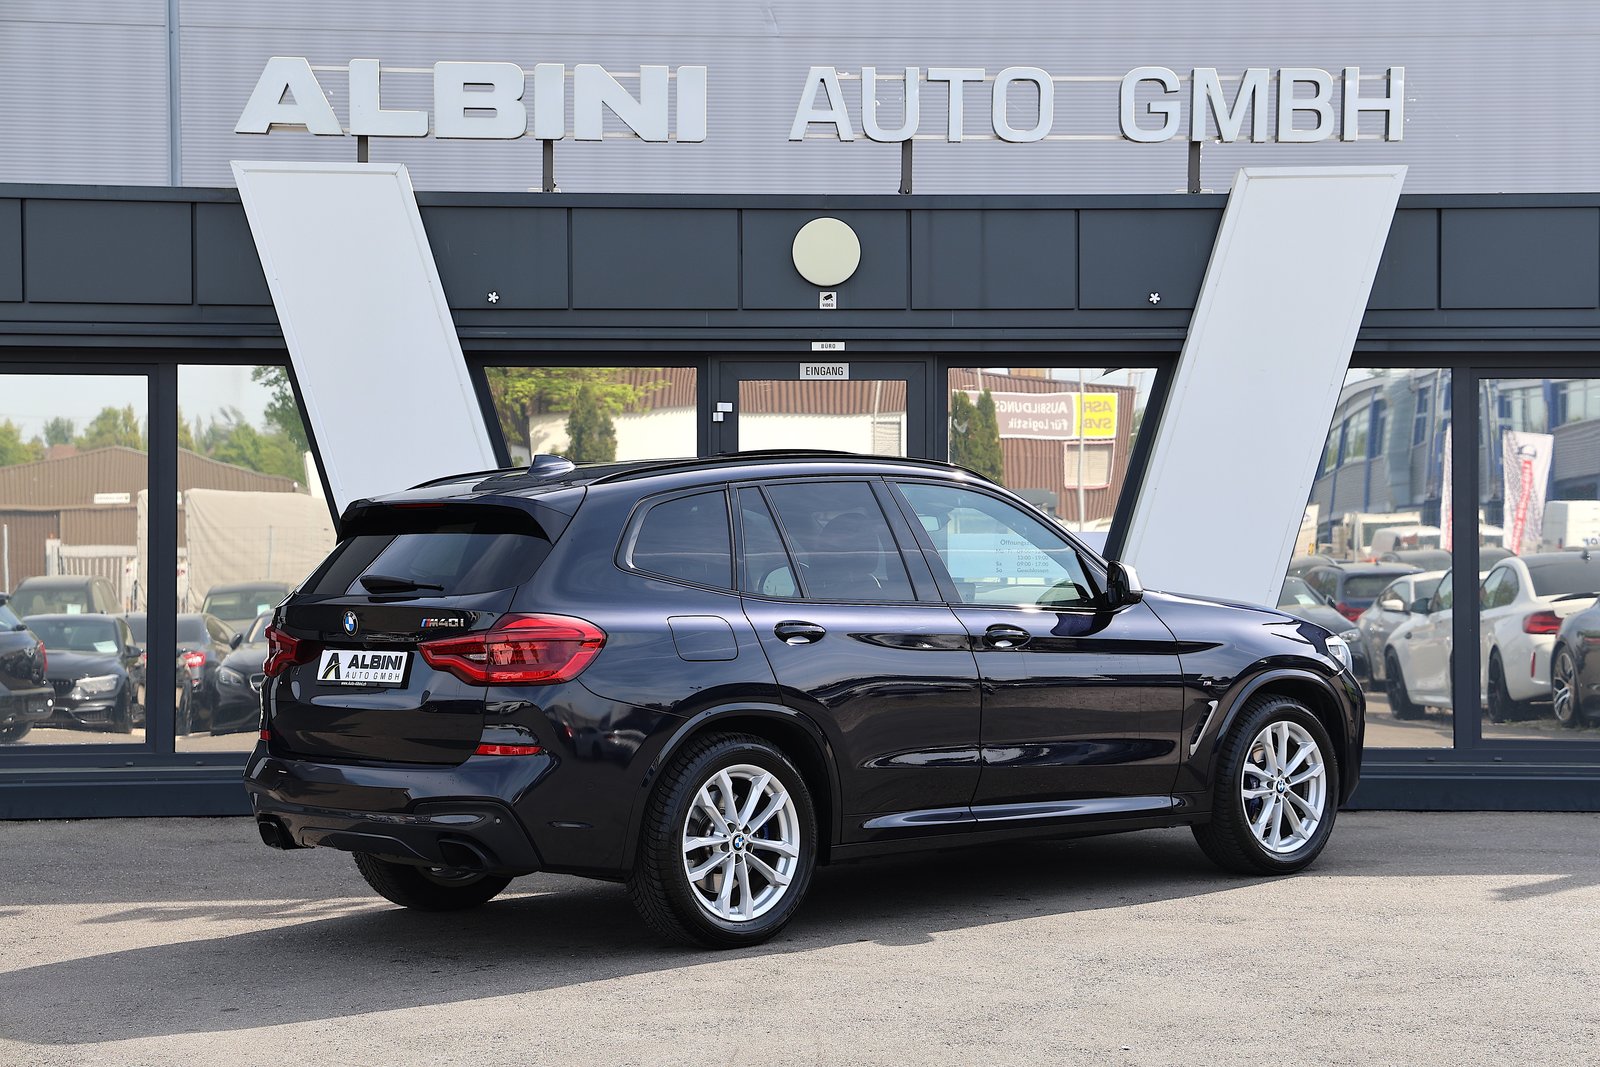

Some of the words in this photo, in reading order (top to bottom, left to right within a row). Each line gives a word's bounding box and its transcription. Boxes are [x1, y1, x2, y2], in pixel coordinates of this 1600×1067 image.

[234, 56, 707, 143] ALBINI
[788, 66, 1054, 143] AUTO
[1119, 65, 1406, 143] GMBH
[805, 366, 844, 376] EINGANG
[347, 654, 404, 671] ALBINI
[345, 671, 370, 680] AUTO
[373, 671, 400, 681] GMBH
